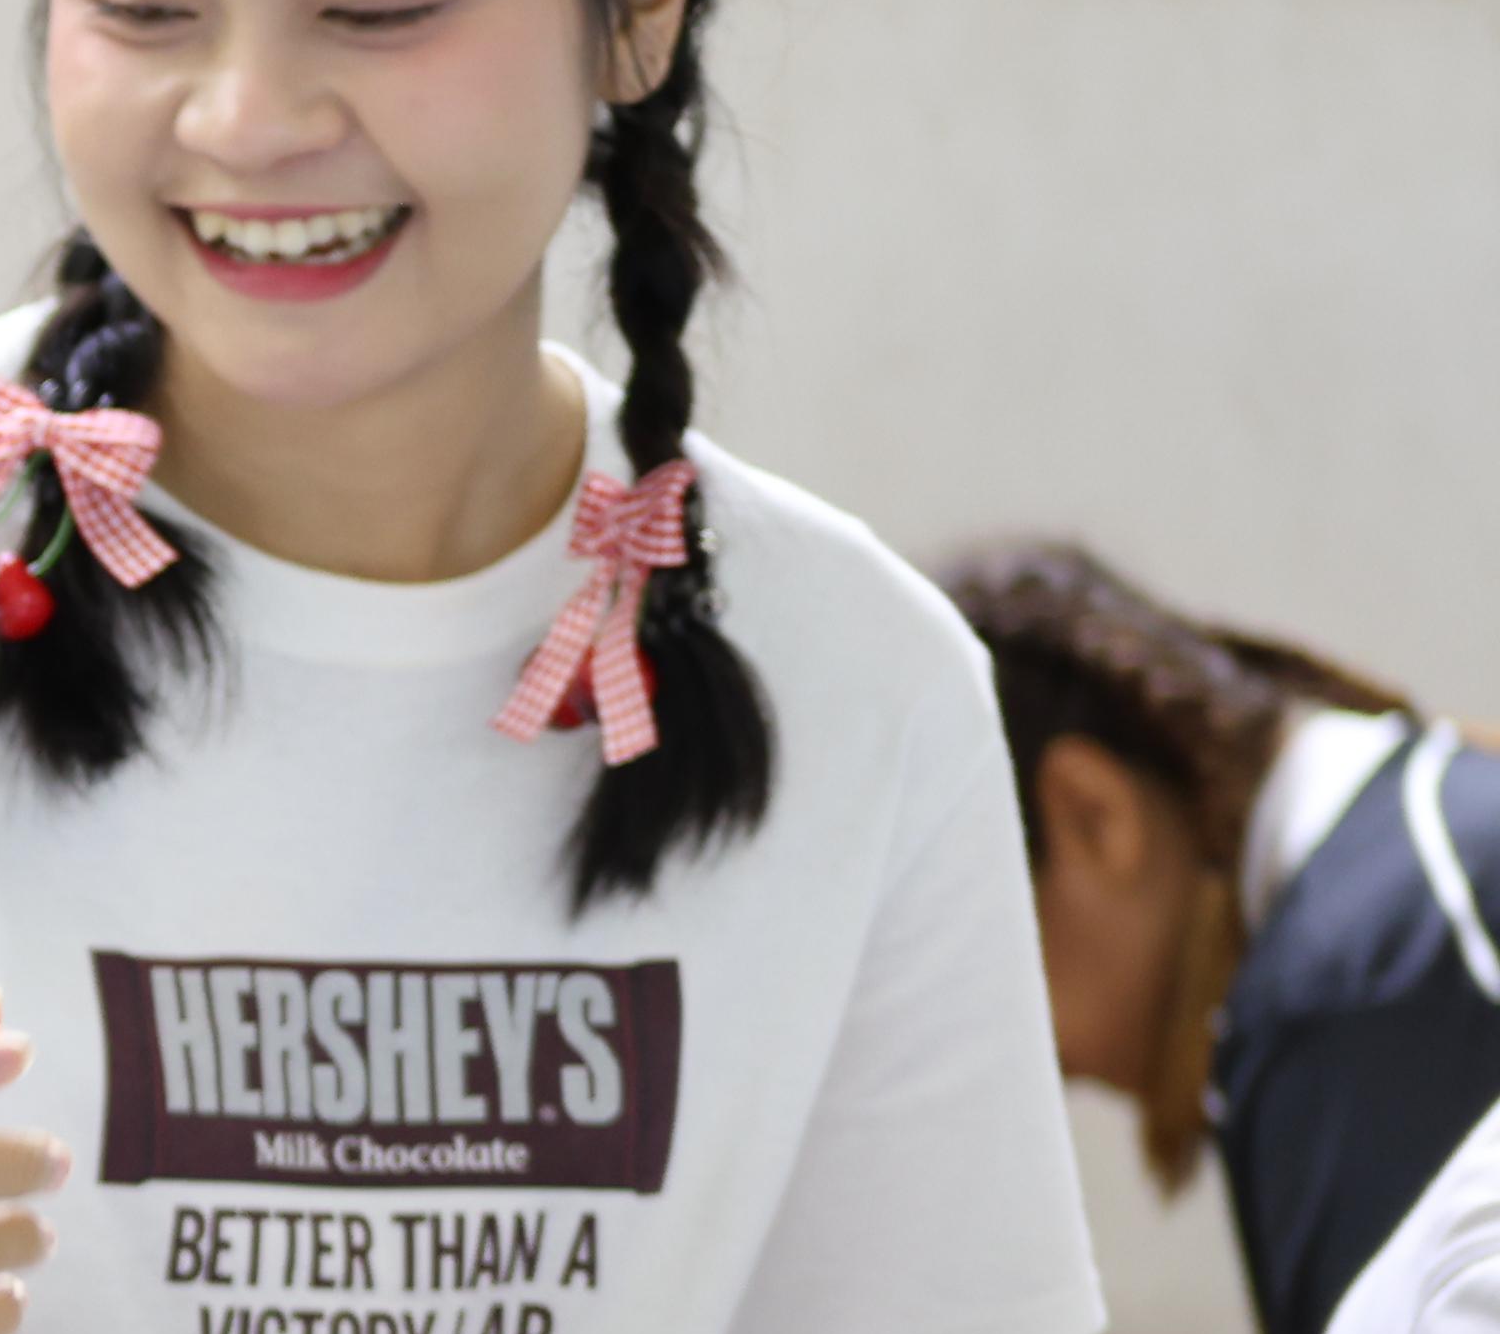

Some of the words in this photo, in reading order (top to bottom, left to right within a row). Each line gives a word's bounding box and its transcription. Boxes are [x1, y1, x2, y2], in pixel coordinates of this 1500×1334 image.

[149, 964, 625, 1128] HERSHEY'S
[254, 1130, 328, 1170] Milk
[333, 1132, 530, 1174] Chocolate
[164, 1205, 375, 1292] BETTER
[391, 1209, 546, 1291] THAN
[559, 1211, 599, 1290] A
